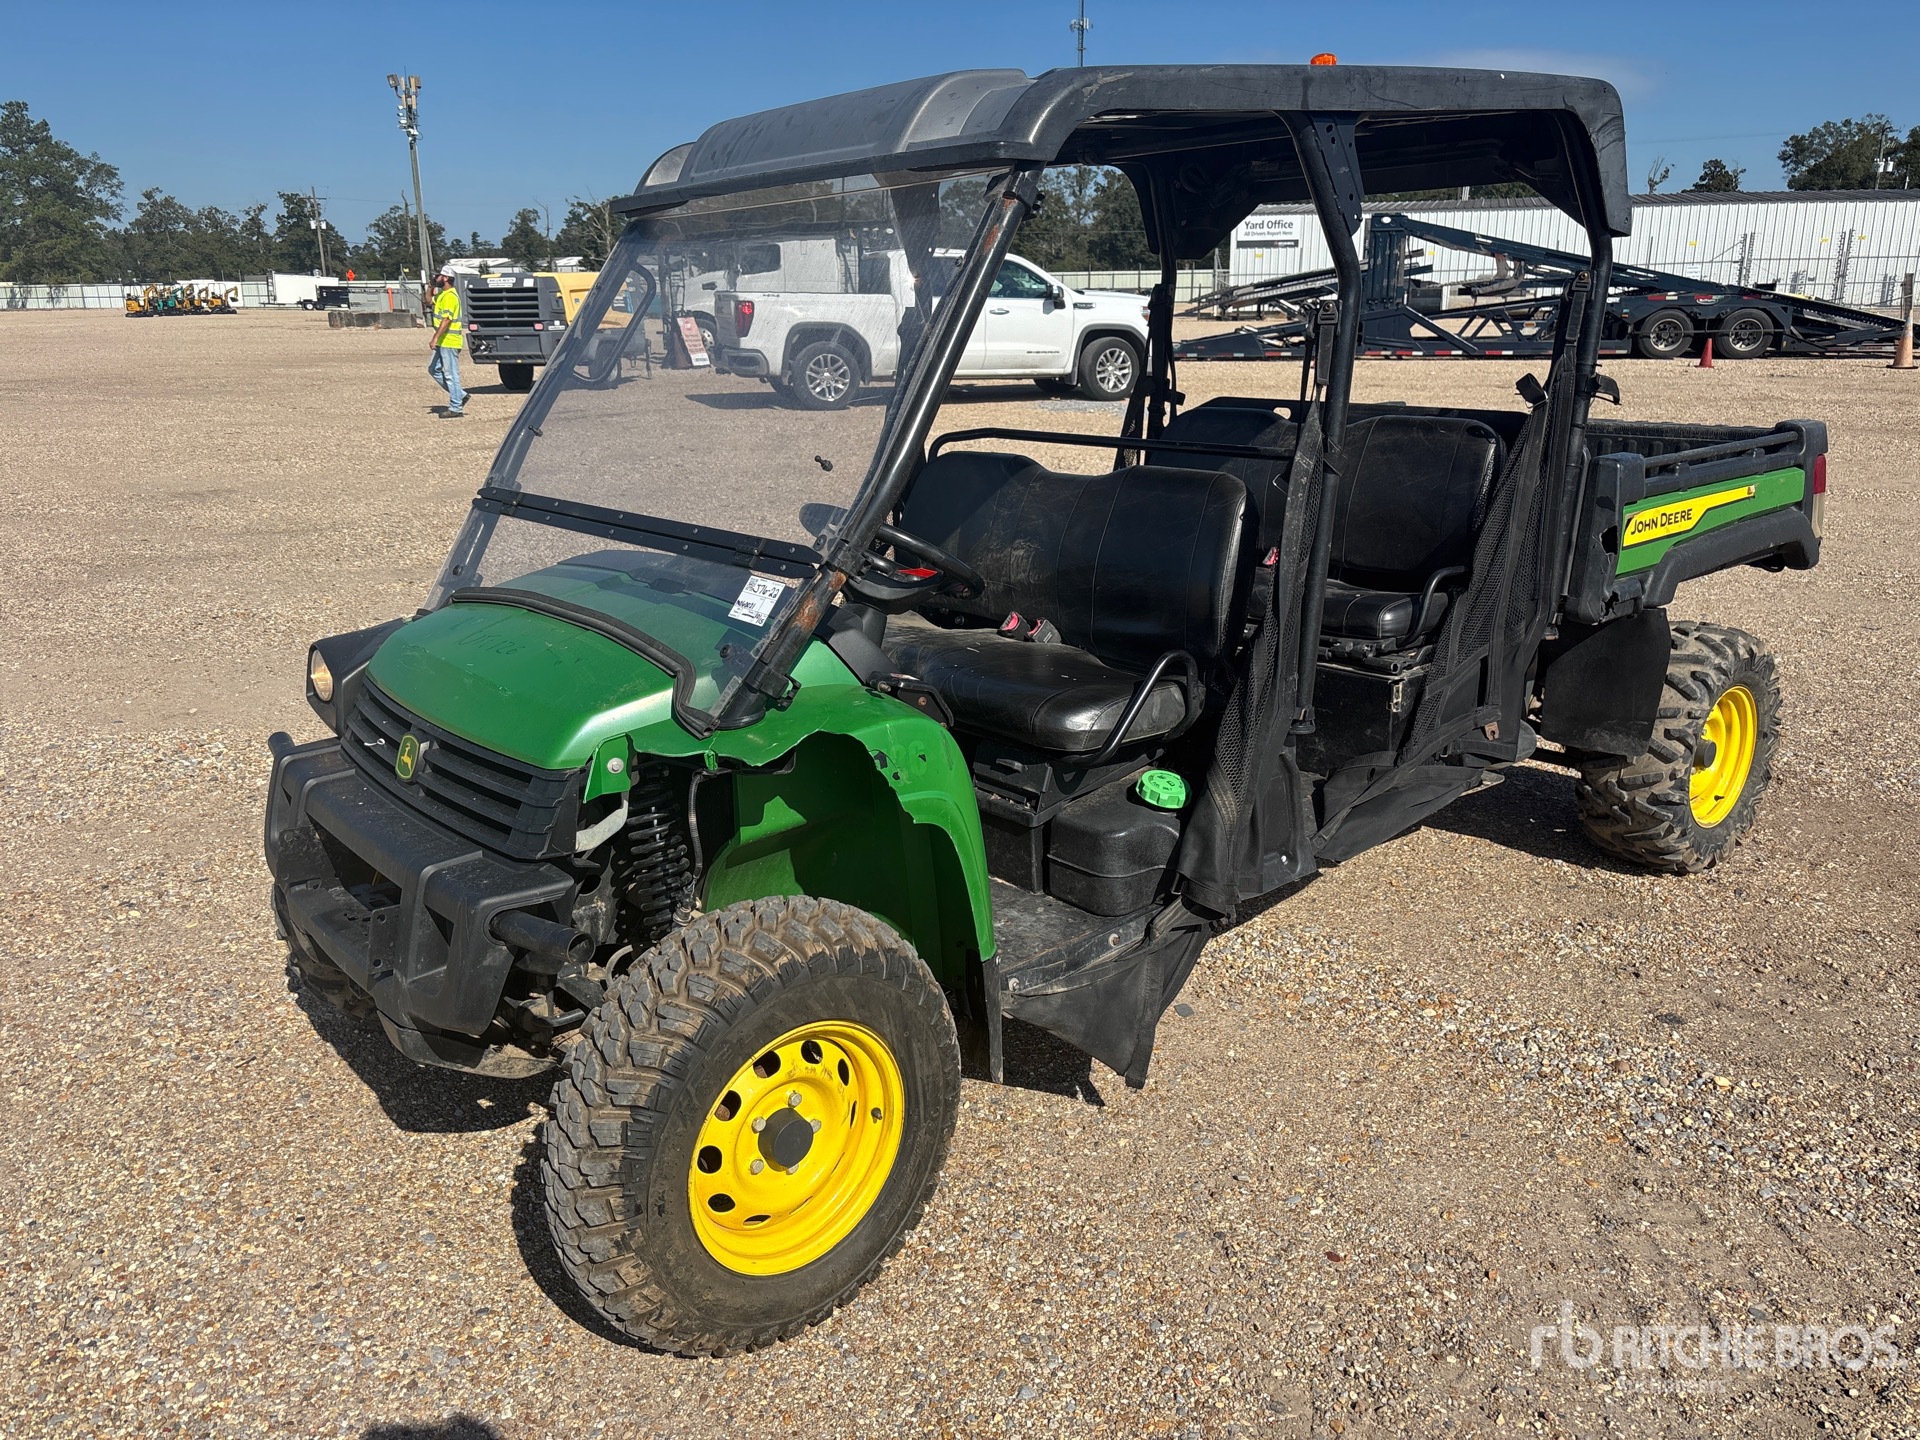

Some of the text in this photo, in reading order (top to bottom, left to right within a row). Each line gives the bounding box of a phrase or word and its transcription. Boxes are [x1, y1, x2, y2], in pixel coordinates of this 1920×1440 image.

[1244, 219, 1294, 230] Yard Office
[1631, 508, 1693, 535] JOHN DEERE
